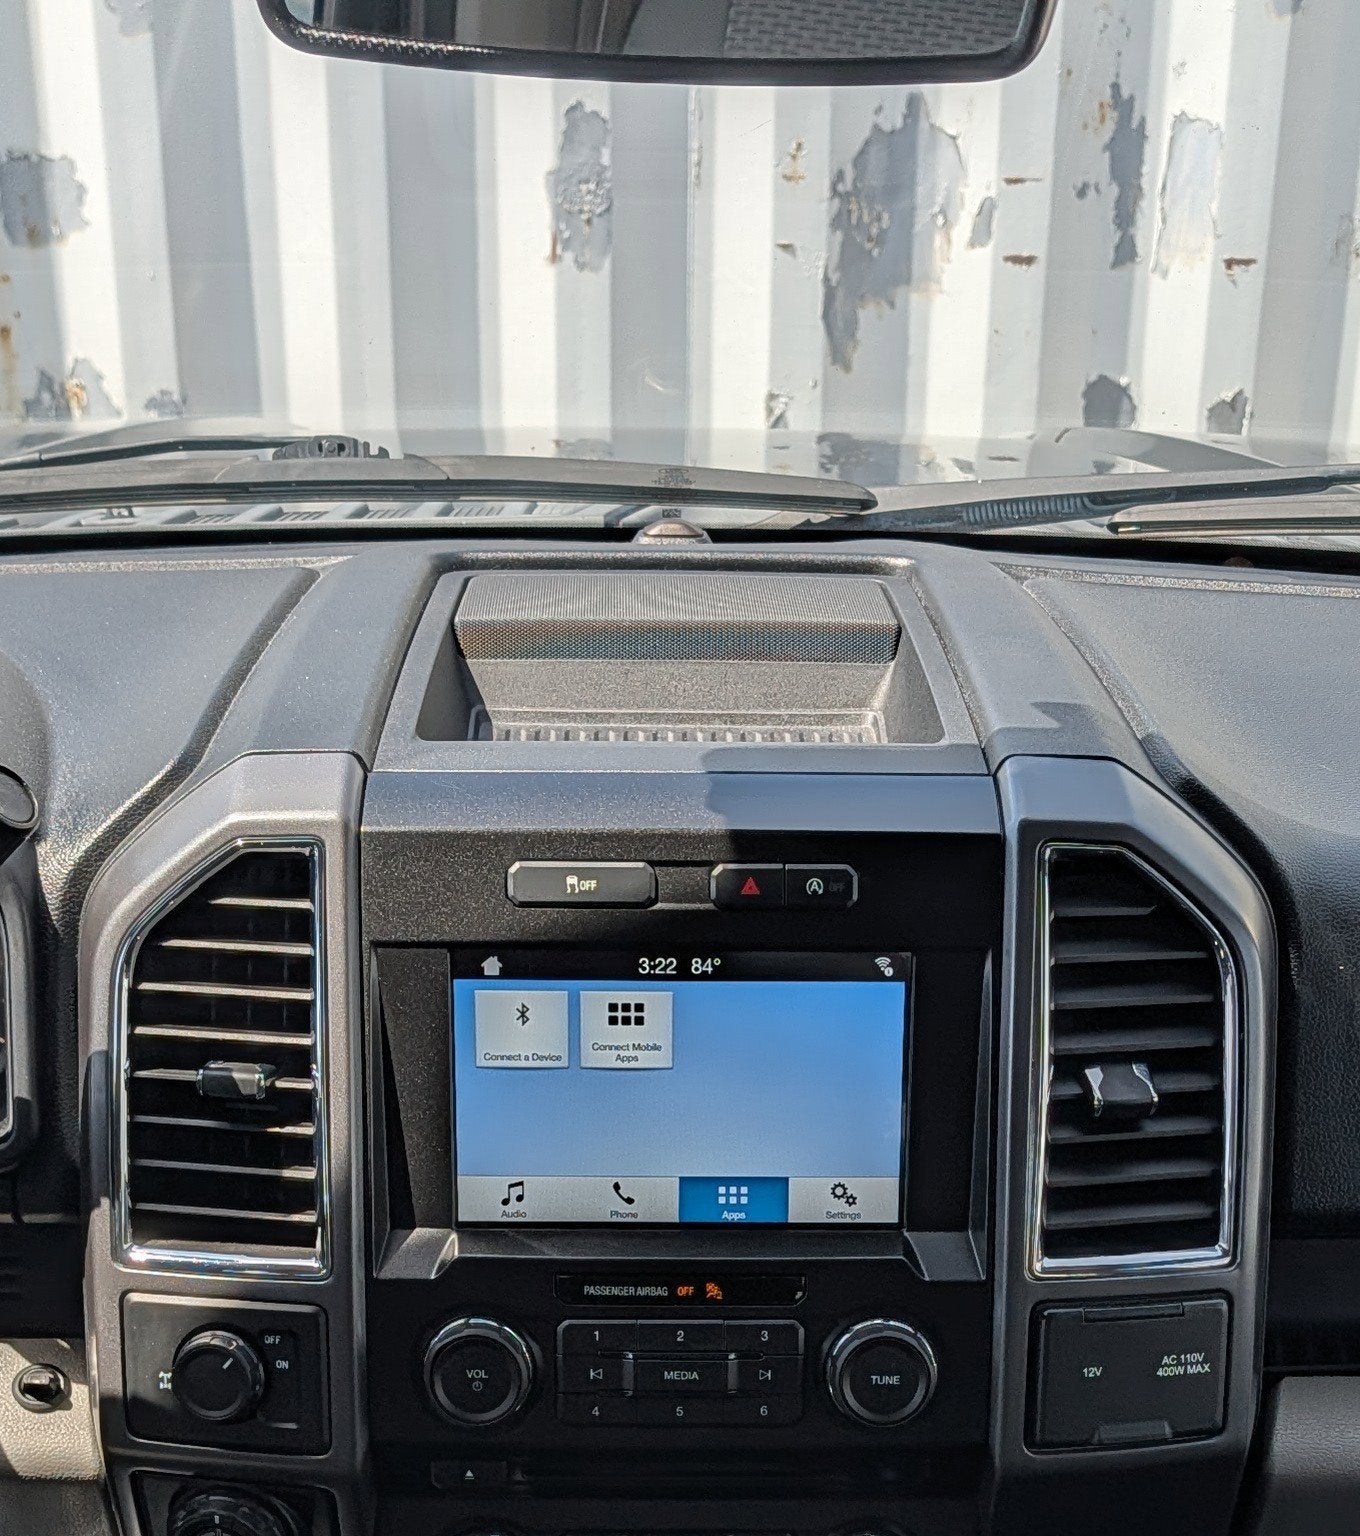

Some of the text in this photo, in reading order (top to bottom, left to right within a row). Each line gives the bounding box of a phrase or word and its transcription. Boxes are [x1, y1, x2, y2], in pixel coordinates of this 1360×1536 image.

[579, 879, 597, 891] OFF
[637, 957, 678, 975] 3:22
[591, 1041, 662, 1052] Connect Mobile
[483, 1052, 522, 1062] Connect
[532, 1052, 563, 1062] Device
[615, 1053, 639, 1064] Apps
[501, 1209, 527, 1219] Audio
[609, 1209, 638, 1219] Phone
[722, 1209, 746, 1221] Apps
[825, 1209, 862, 1221] Settings
[583, 1285, 695, 1297] PASSENGER AIRBAG OFF
[263, 1335, 282, 1345] OFF
[593, 1330, 600, 1342] 1
[676, 1330, 685, 1342] 2
[760, 1330, 769, 1342] 3
[275, 1359, 289, 1370] ON
[1161, 1353, 1205, 1365] AC 110V
[465, 1369, 489, 1380] VOL
[663, 1370, 700, 1381] MEDIA
[1082, 1367, 1103, 1378] 12V
[1156, 1363, 1211, 1378] 400W MAX
[870, 1374, 901, 1386] TUNE
[591, 1406, 600, 1417] 4
[675, 1406, 684, 1417] 5
[759, 1405, 768, 1417] 6
